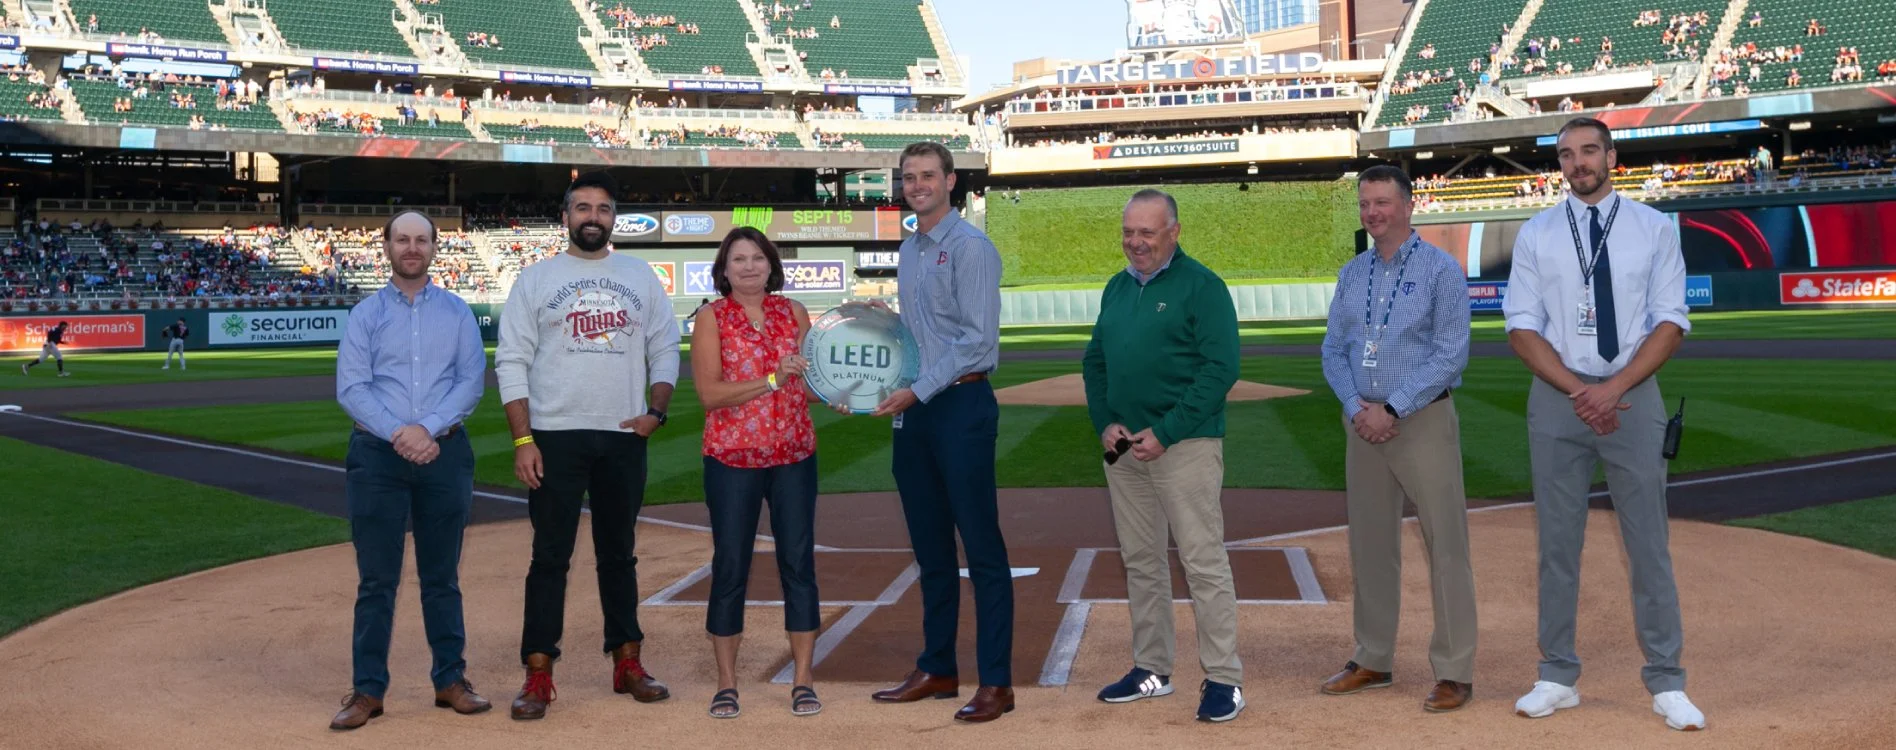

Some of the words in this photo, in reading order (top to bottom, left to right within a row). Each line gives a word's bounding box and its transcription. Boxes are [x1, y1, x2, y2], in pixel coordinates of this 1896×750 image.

[151, 46, 178, 56] Home
[178, 48, 197, 58] Run
[197, 50, 223, 60] Porch
[352, 61, 375, 70] Home
[376, 62, 392, 71] Run
[392, 63, 414, 73] Porch
[1056, 58, 1189, 85] TARGET
[1222, 51, 1324, 77] FIELD
[533, 73, 554, 82] Home
[554, 75, 568, 83] Run
[568, 76, 588, 84] Porch
[724, 82, 738, 90] Run
[876, 86, 890, 94] Run
[1610, 130, 1632, 140] URE
[1636, 126, 1677, 138] ISLAND
[1682, 122, 1711, 135] COVE
[1124, 145, 1161, 156] DELTA
[612, 217, 648, 232] Ford
[793, 210, 834, 225] SEPT
[836, 210, 853, 225] 15
[860, 252, 875, 264] HIT
[875, 252, 893, 264] THE
[546, 285, 574, 310] World
[568, 278, 598, 291] Series
[599, 277, 644, 312] Champions
[250, 317, 337, 332] securian
[566, 309, 628, 338] Twins
[251, 333, 302, 341] FINANCIAL
[829, 342, 891, 369] LEED
[833, 371, 885, 384] PLATINUM
